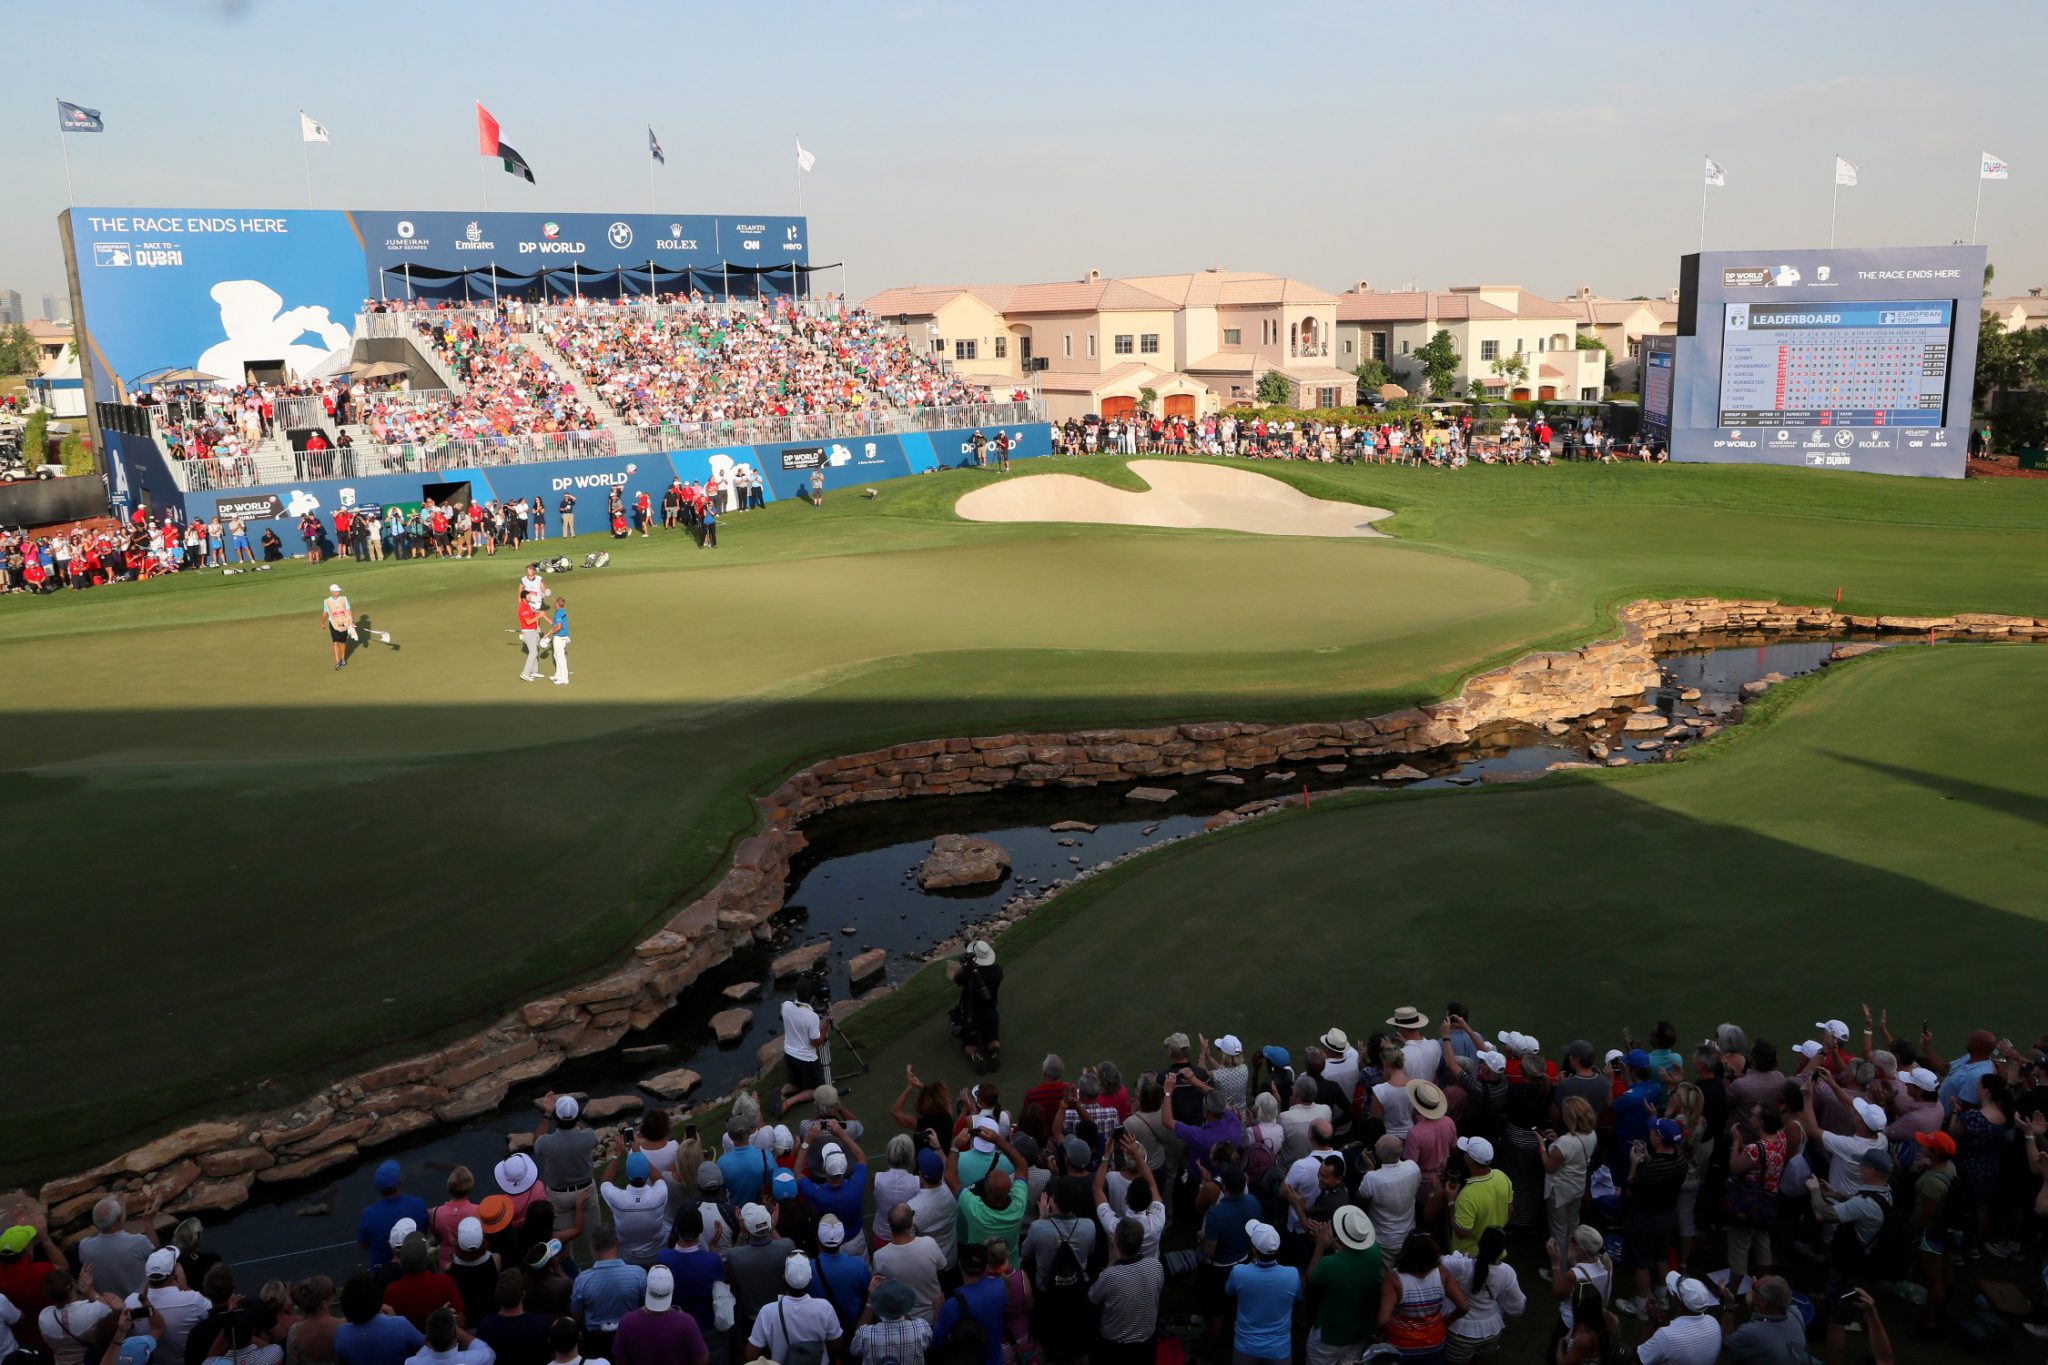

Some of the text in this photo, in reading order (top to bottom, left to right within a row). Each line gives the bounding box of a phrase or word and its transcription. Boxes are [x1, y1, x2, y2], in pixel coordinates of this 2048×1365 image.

[88, 218, 288, 233] THE RACE ENDS HERE
[455, 240, 494, 250] Emirates
[519, 242, 585, 254] DP WORLD
[656, 240, 698, 250] ROLEX
[744, 240, 760, 250] CNN
[136, 250, 183, 267] DUBAI
[1879, 271, 1905, 279] RACE
[1907, 270, 1933, 278] ENDS
[1934, 270, 1960, 278] HERE
[1753, 314, 1840, 324] LEADERBOARD
[794, 453, 818, 461] WORLD
[1826, 456, 1850, 465] DUBAI
[552, 472, 628, 491] DP WORLD
[234, 502, 271, 511] WORLD
